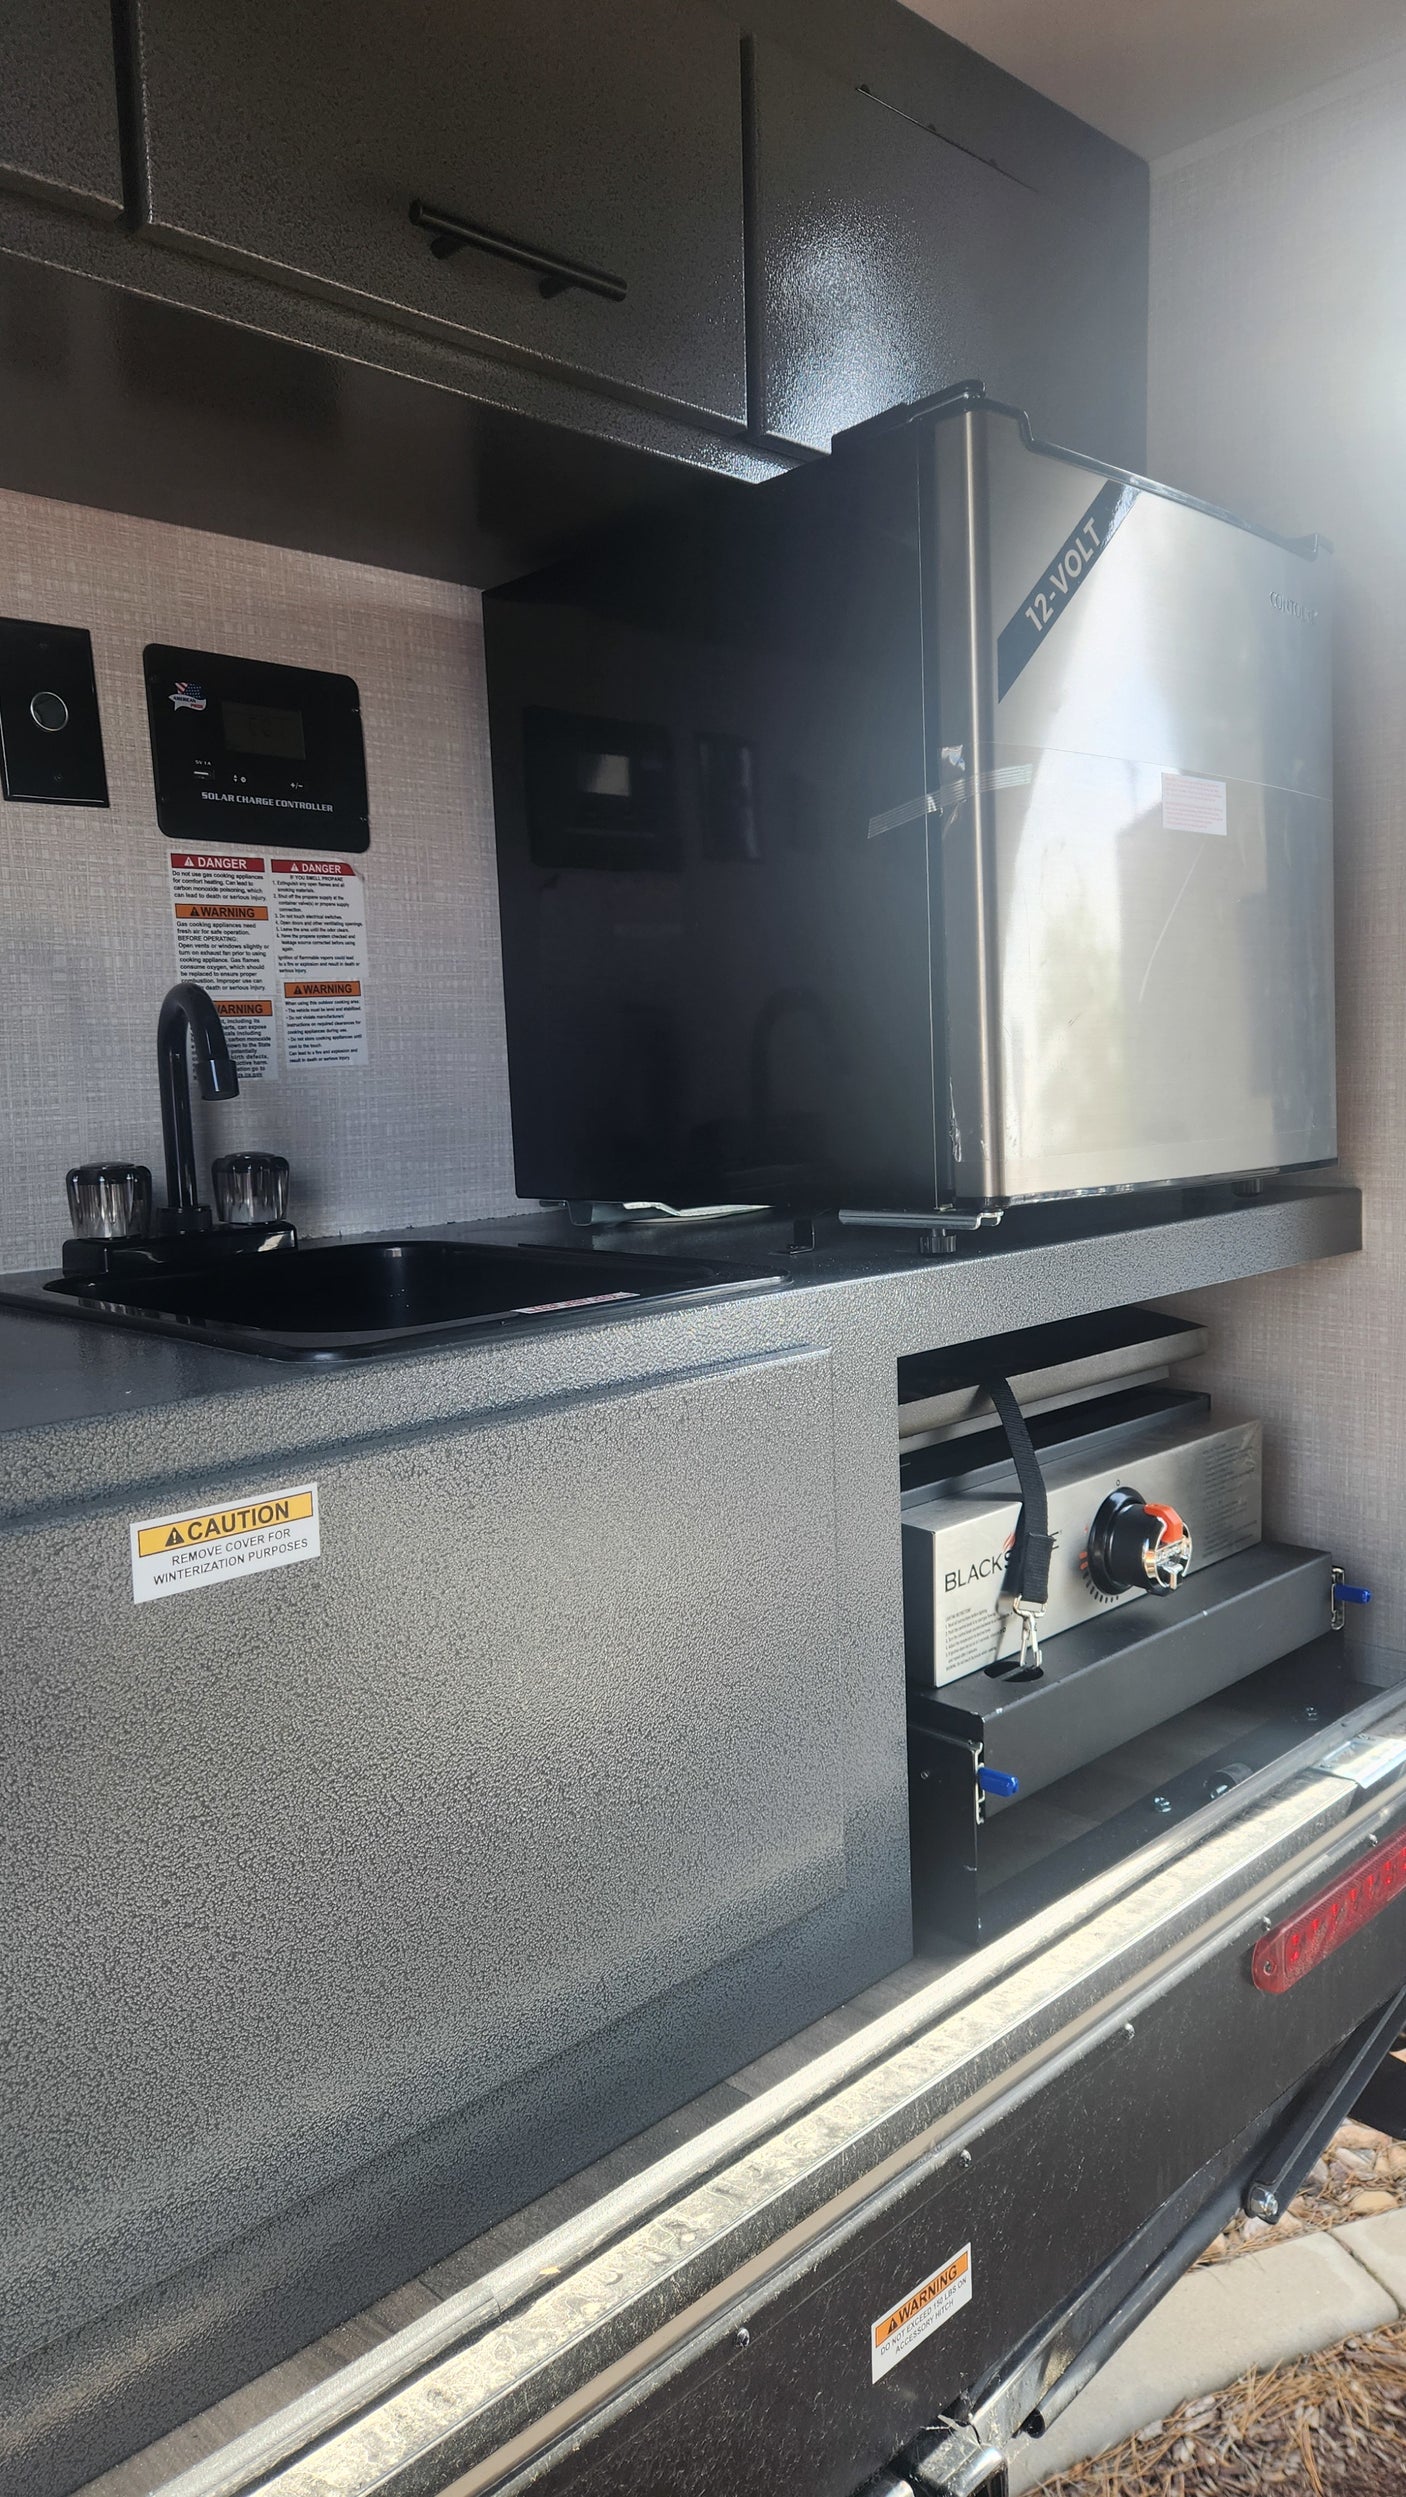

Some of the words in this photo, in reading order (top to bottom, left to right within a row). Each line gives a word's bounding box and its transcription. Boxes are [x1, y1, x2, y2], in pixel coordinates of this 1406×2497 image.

[1024, 516, 1103, 632] 12-VOLT
[201, 791, 234, 802] SOLAR
[236, 795, 274, 806] CHARGE
[275, 799, 333, 812] CONTROLLER
[198, 857, 247, 869] DANGER
[302, 863, 342, 874] DANGER
[200, 907, 255, 918] WARNING
[303, 984, 352, 994] WARNING
[188, 1501, 290, 1541] CAUTION
[154, 1555, 245, 1585] WINTERIZATION
[249, 1539, 308, 1562] PURPOSES
[172, 1545, 222, 1566] REMOVE
[226, 1534, 264, 1552] COVER
[269, 1528, 290, 1542] FOR
[898, 2265, 957, 2323] WARNING
[880, 2343, 890, 2356] DO
[892, 2331, 905, 2345] NOT
[907, 2307, 932, 2333] EXCEED
[945, 2288, 956, 2301] LBS
[958, 2276, 967, 2289] ON
[895, 2316, 934, 2355] ACCESSORY
[936, 2299, 954, 2319] HITCH
